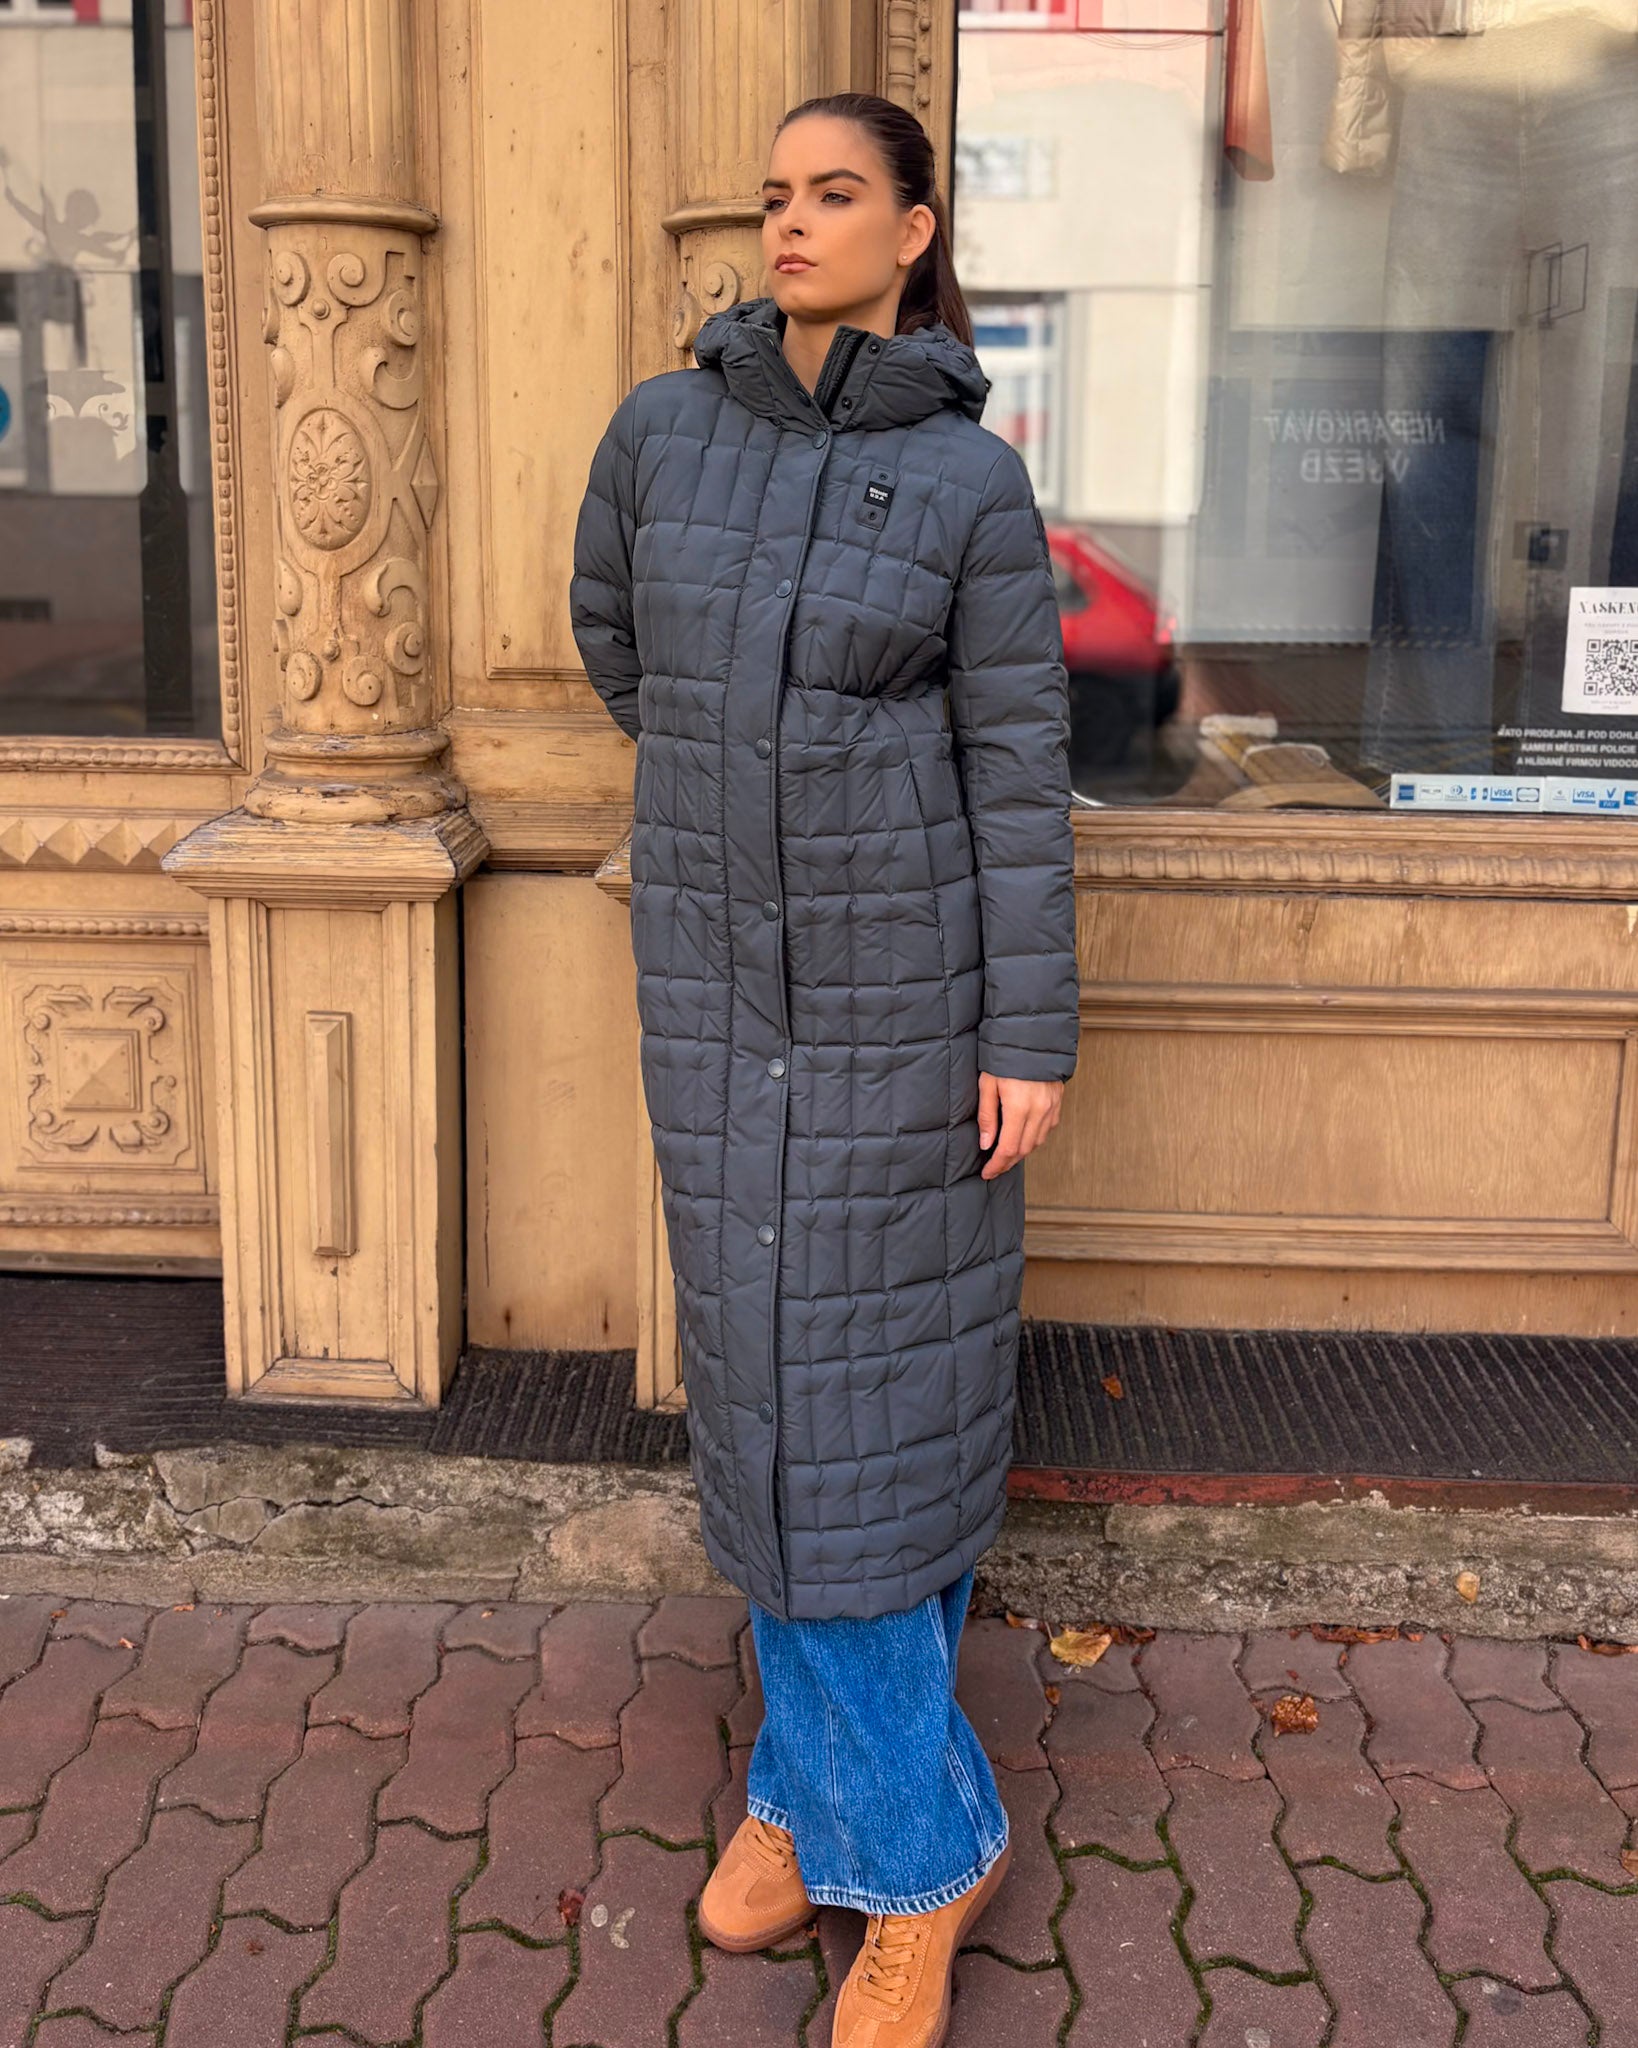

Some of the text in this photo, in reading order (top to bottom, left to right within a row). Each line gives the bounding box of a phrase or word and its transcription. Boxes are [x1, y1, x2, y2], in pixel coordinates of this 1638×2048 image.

[1579, 601, 1638, 613] NASKEN
[1524, 728, 1572, 738] PRODEJNA
[1574, 729, 1586, 739] JE
[1588, 730, 1607, 739] POD
[1521, 743, 1553, 752] KAMER
[1600, 744, 1636, 753] POLICIE
[1516, 757, 1523, 765] A
[1566, 758, 1602, 767] FIRMOU
[1494, 789, 1513, 797] VISA
